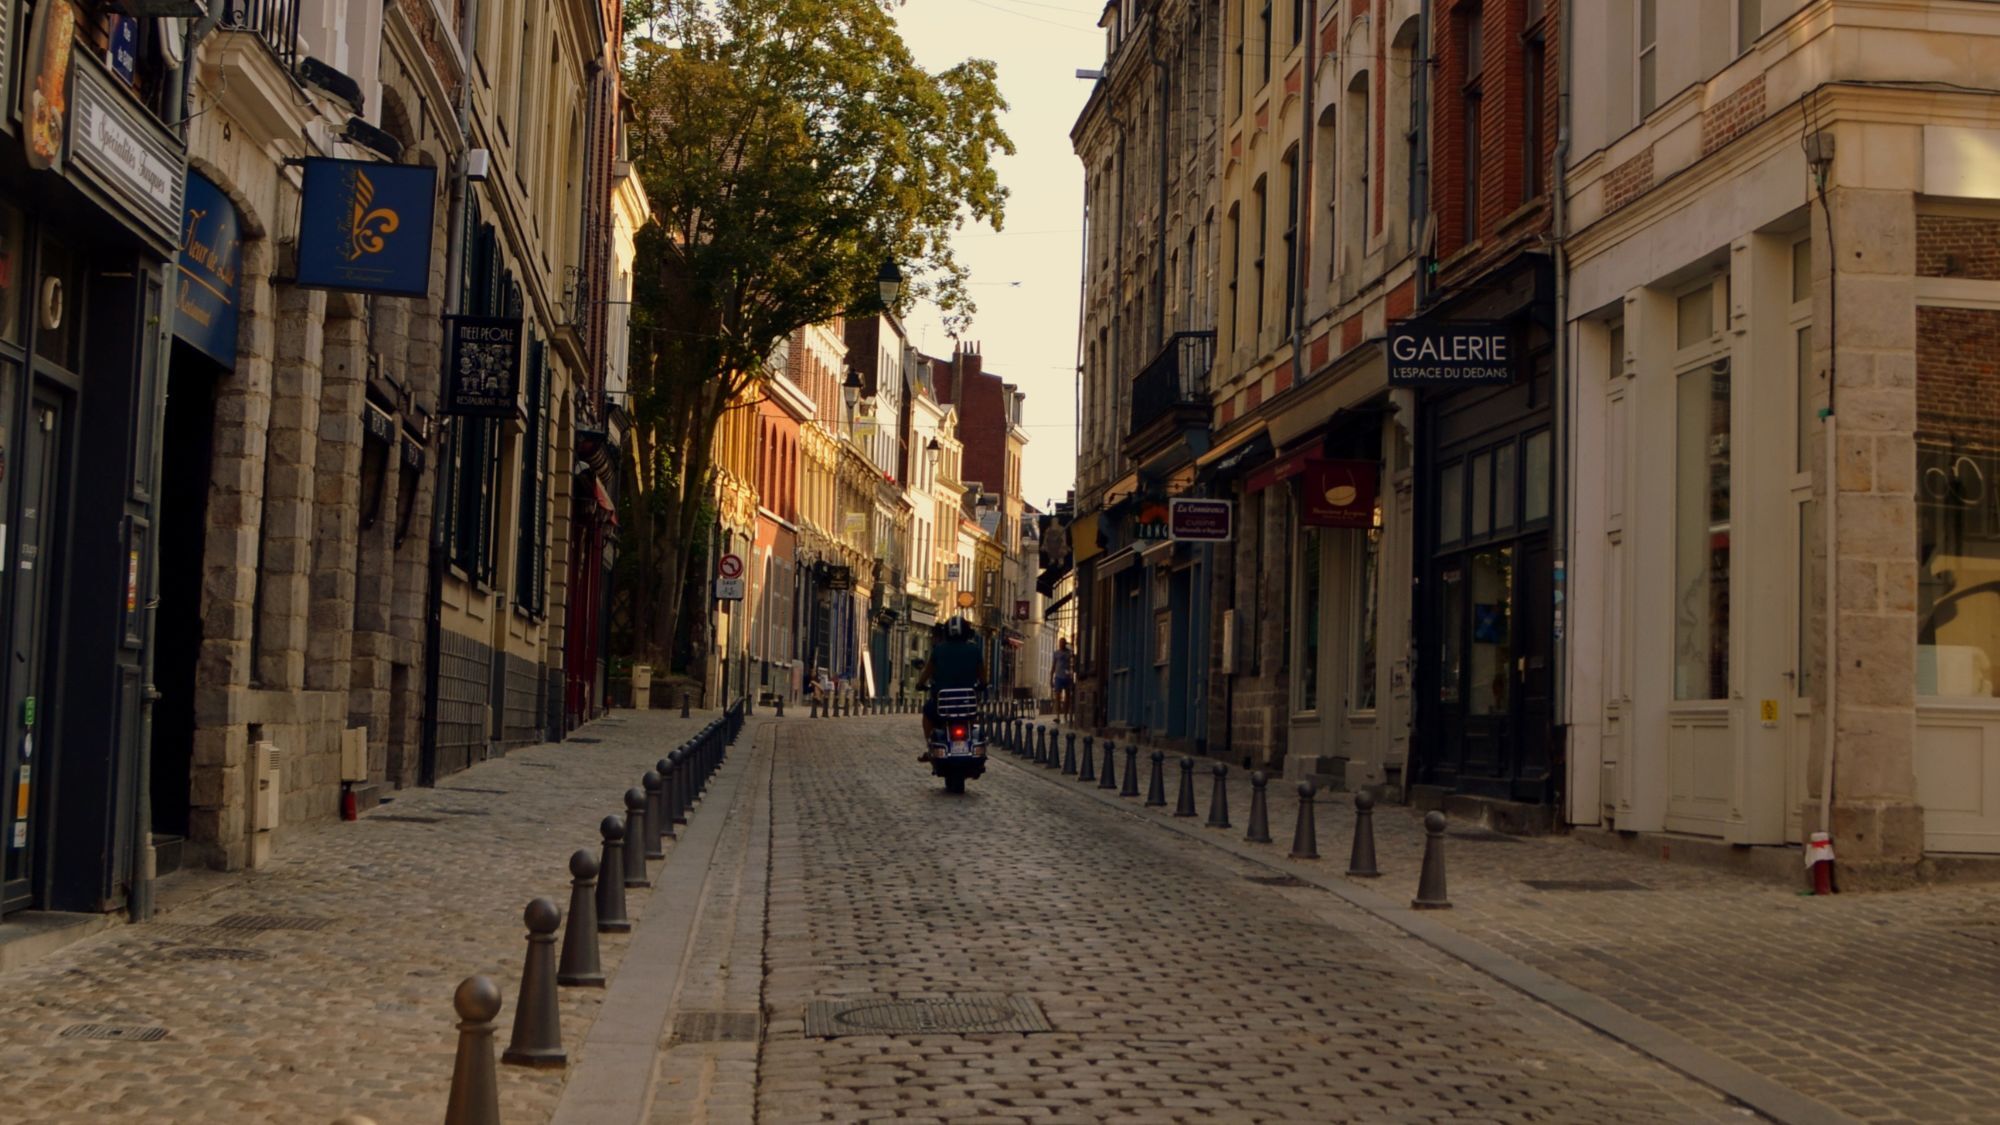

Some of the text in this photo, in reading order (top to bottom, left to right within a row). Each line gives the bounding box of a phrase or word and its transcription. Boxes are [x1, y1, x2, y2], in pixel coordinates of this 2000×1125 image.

[123, 22, 131, 42] Rue
[117, 46, 123, 63] de
[460, 326, 515, 342] MEET PEOPLE
[1392, 335, 1506, 361] GALERIE
[1393, 367, 1508, 378] L'ESPACE DU DEDANS
